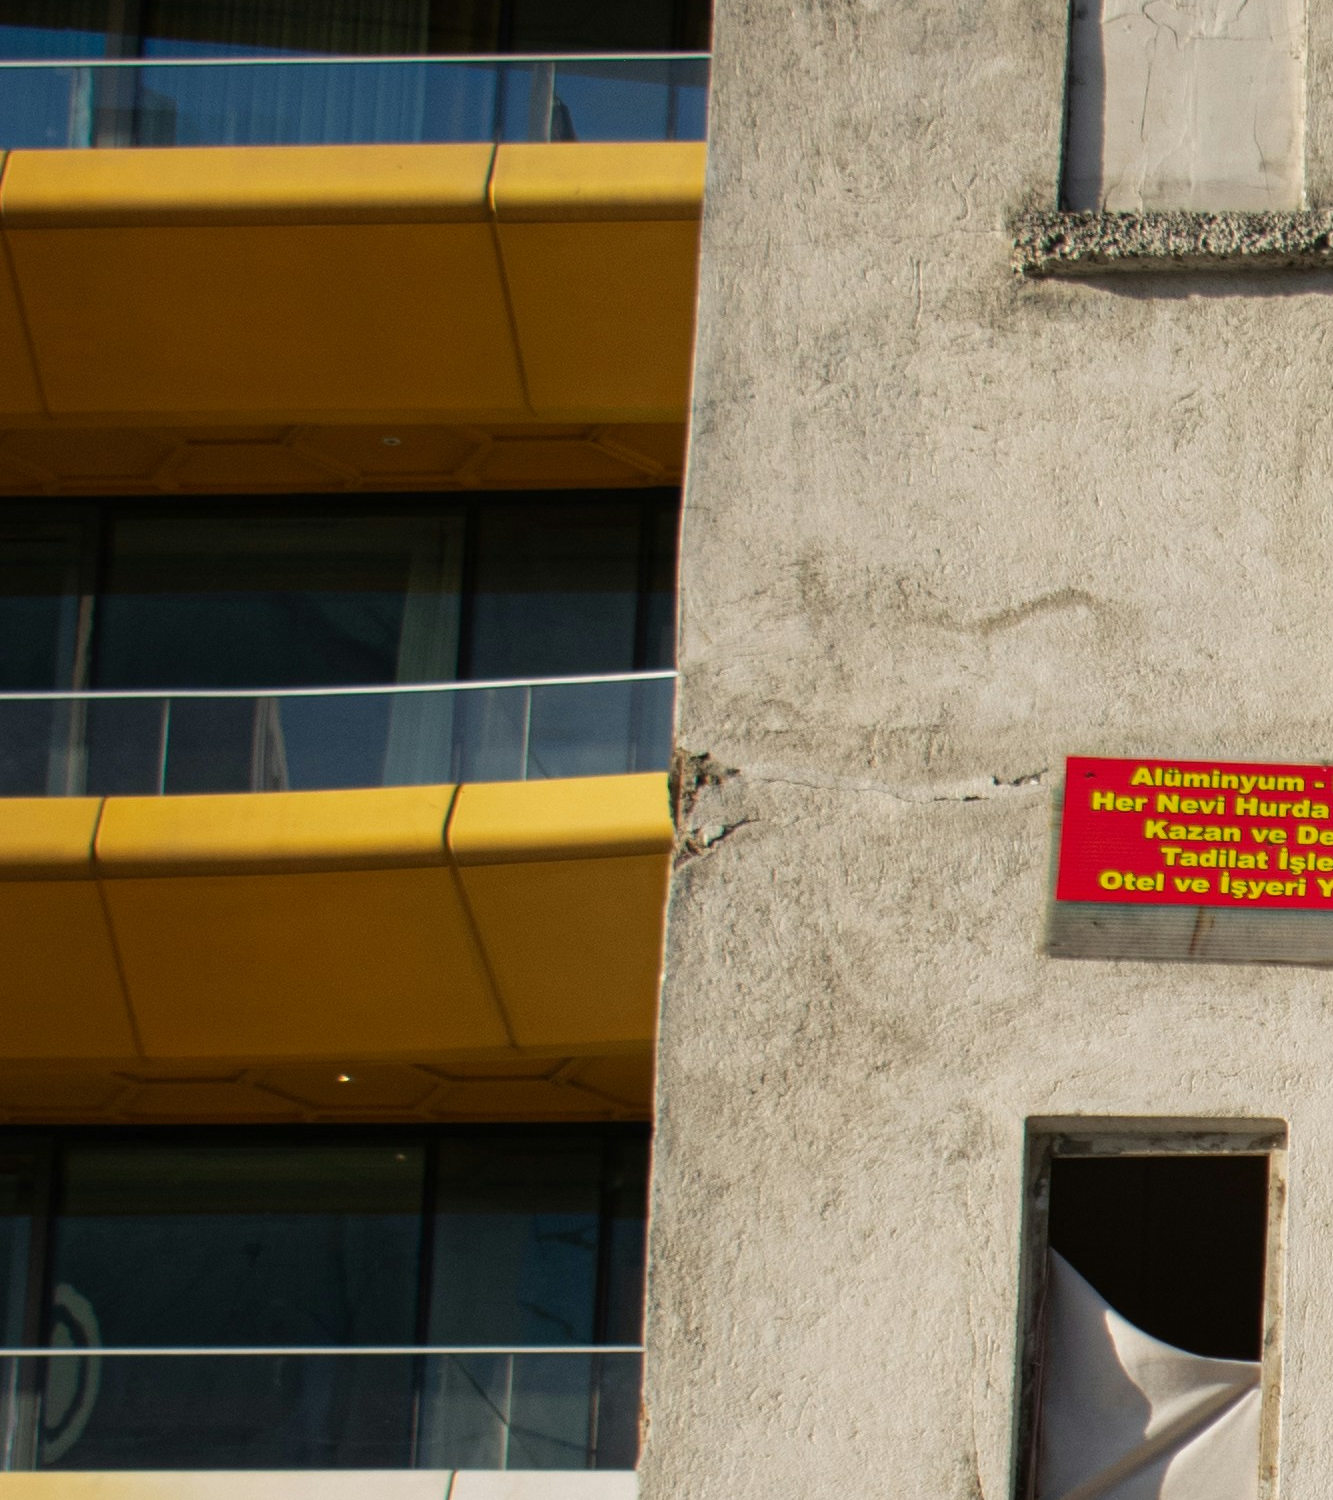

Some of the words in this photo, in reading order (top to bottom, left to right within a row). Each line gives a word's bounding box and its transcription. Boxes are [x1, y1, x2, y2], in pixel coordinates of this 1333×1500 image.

[1130, 767, 1305, 794] Alüminyum
[1091, 791, 1149, 812] Her
[1157, 793, 1225, 815] Nevi
[1235, 796, 1329, 819] Hurda
[1144, 819, 1242, 842] Kazan
[1251, 828, 1288, 844] ve
[1161, 846, 1269, 870] Tadilat
[1099, 869, 1165, 892] Otel
[1173, 877, 1211, 893] ve
[1220, 870, 1306, 900] İşyeri
